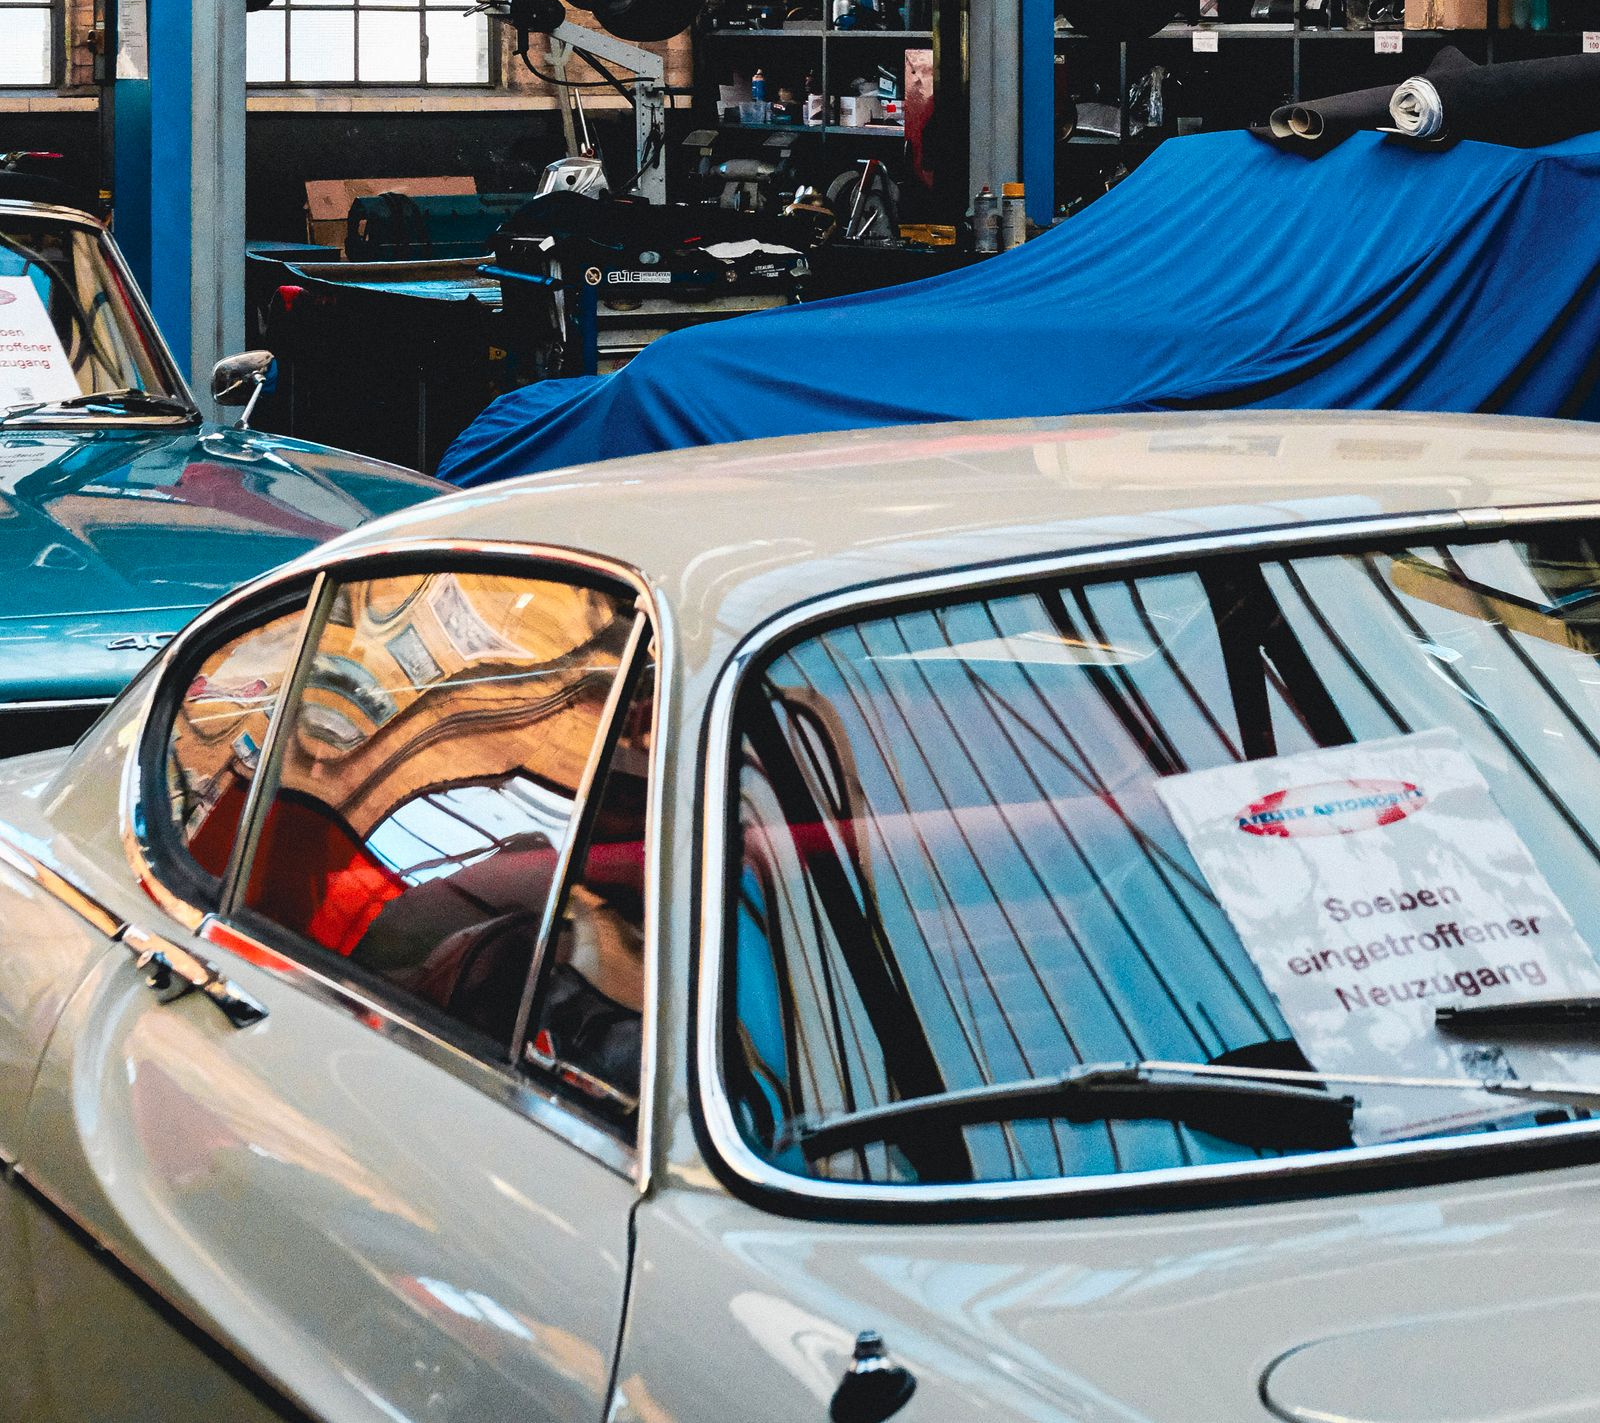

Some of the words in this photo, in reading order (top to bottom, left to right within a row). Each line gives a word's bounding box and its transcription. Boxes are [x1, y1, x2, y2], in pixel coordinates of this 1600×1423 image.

[1324, 885, 1462, 923] Soeben
[1288, 916, 1543, 976] eingetroffener
[1335, 960, 1548, 1012] Neuzugang
